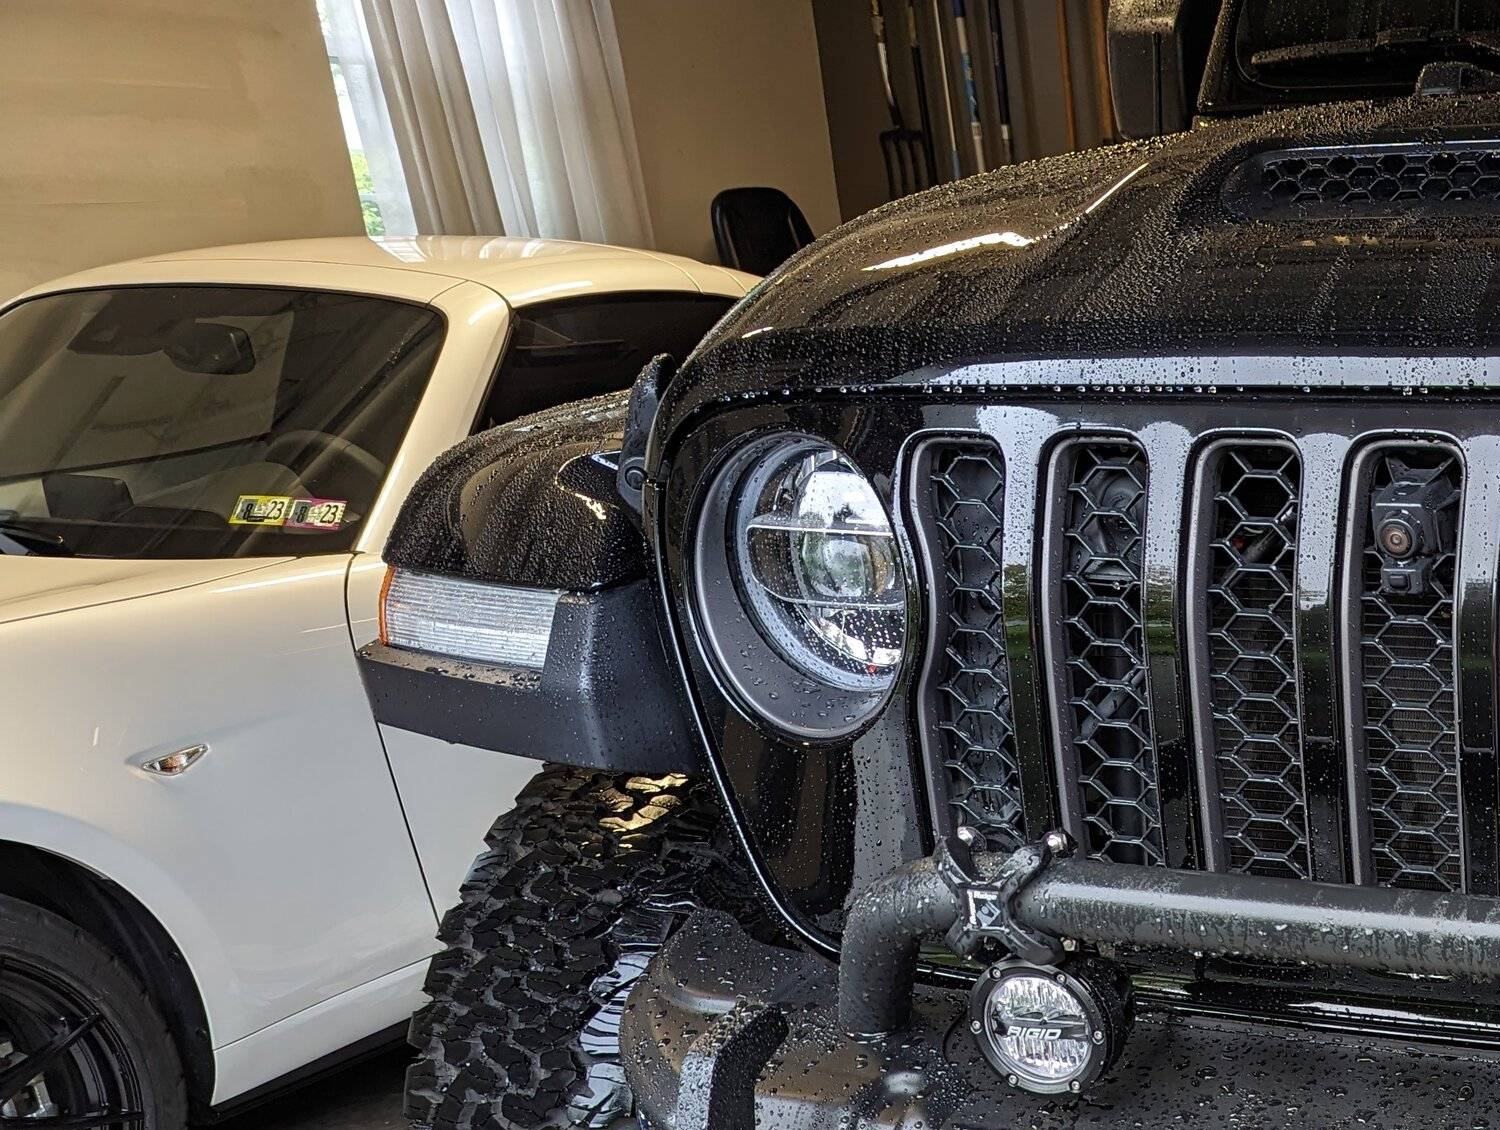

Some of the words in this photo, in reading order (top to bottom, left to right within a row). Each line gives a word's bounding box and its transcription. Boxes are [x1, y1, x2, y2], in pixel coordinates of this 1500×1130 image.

[267, 500, 285, 520] 23
[320, 504, 339, 524] 23
[1007, 1025, 1062, 1040] RIGID
